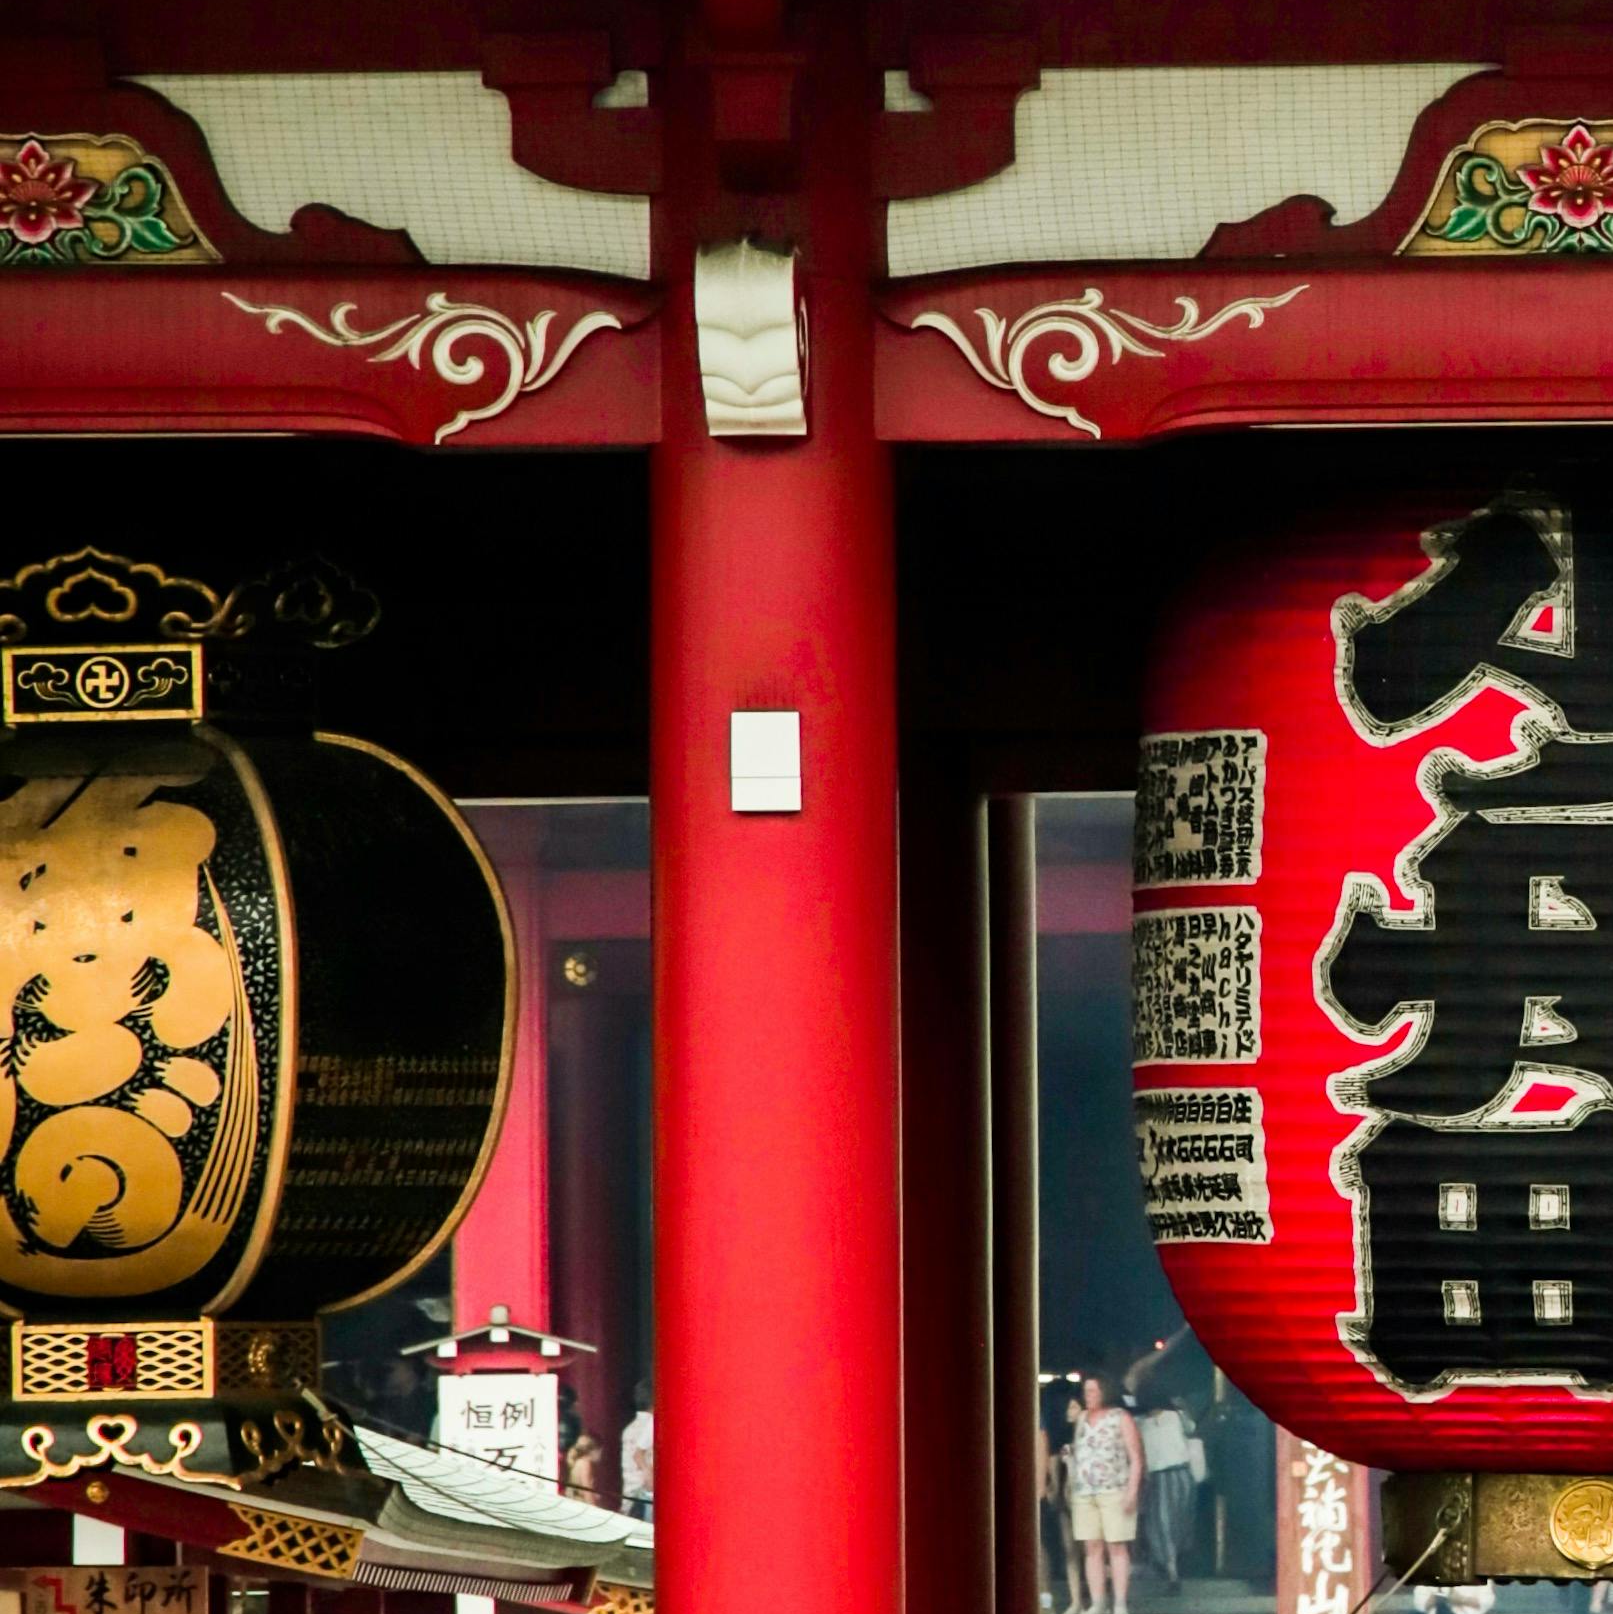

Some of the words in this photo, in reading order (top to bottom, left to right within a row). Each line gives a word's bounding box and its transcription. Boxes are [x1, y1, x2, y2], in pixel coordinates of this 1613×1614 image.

[1200, 913, 1218, 1059] 早川商事
[1235, 913, 1257, 1059] ハタヤリミテッド
[461, 1398, 535, 1430] 恒例
